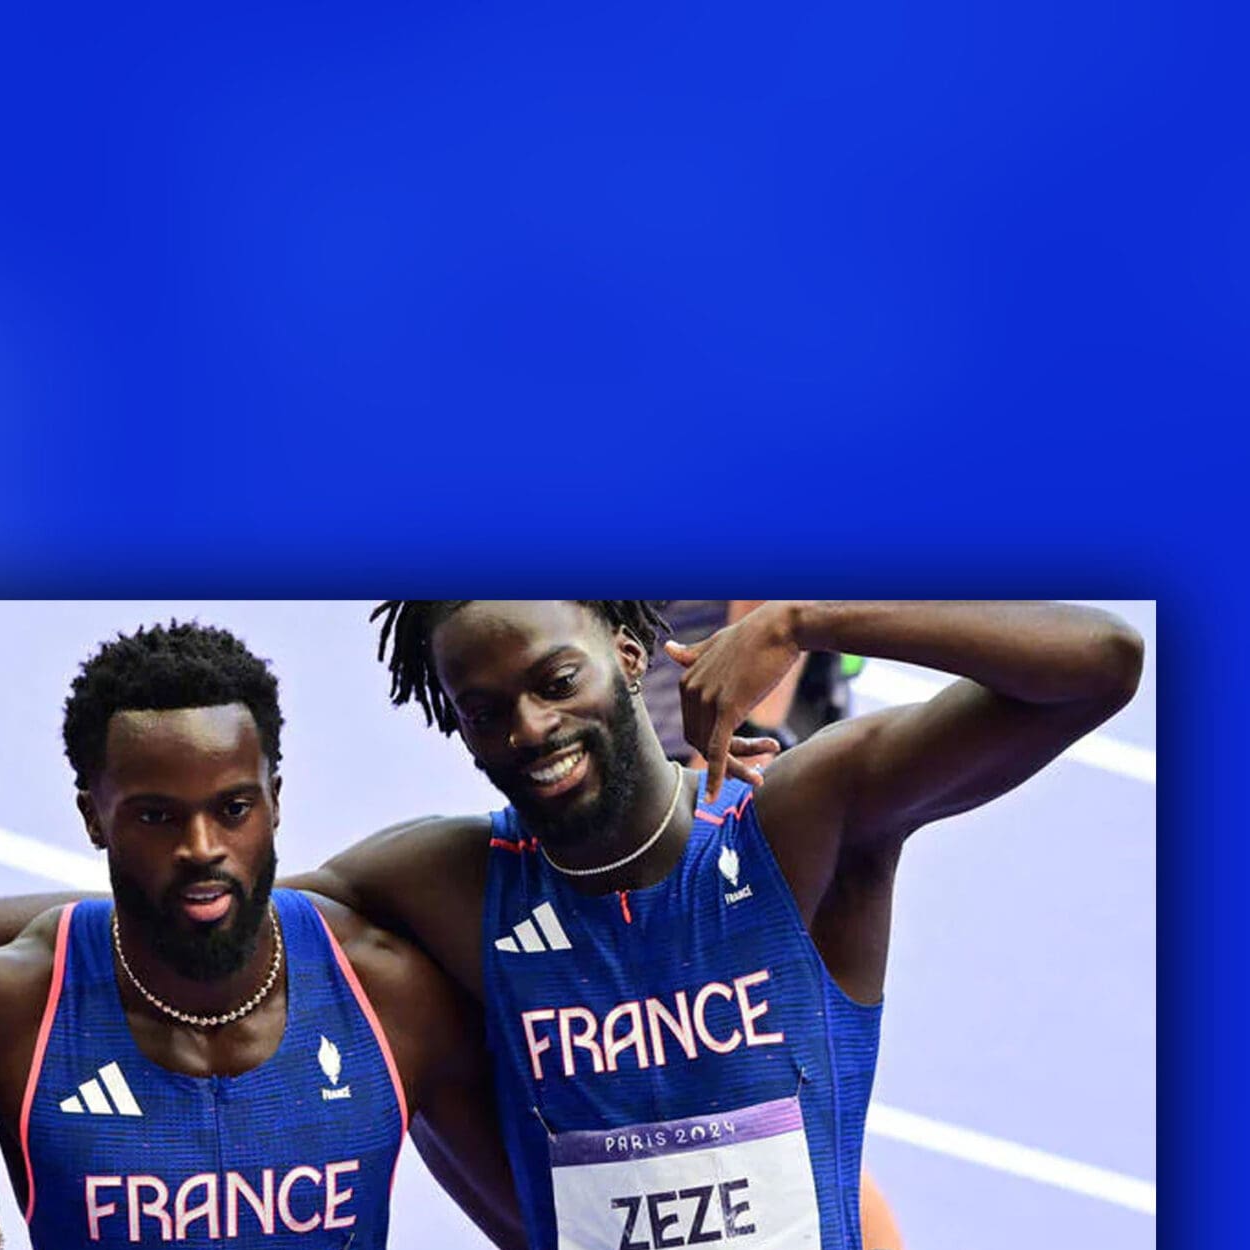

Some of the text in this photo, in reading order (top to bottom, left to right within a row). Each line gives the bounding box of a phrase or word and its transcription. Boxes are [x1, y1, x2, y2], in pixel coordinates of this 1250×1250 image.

[521, 968, 785, 1080] FRANCE
[605, 1120, 735, 1152] PARIS 2024
[85, 1159, 359, 1242] FRANCE
